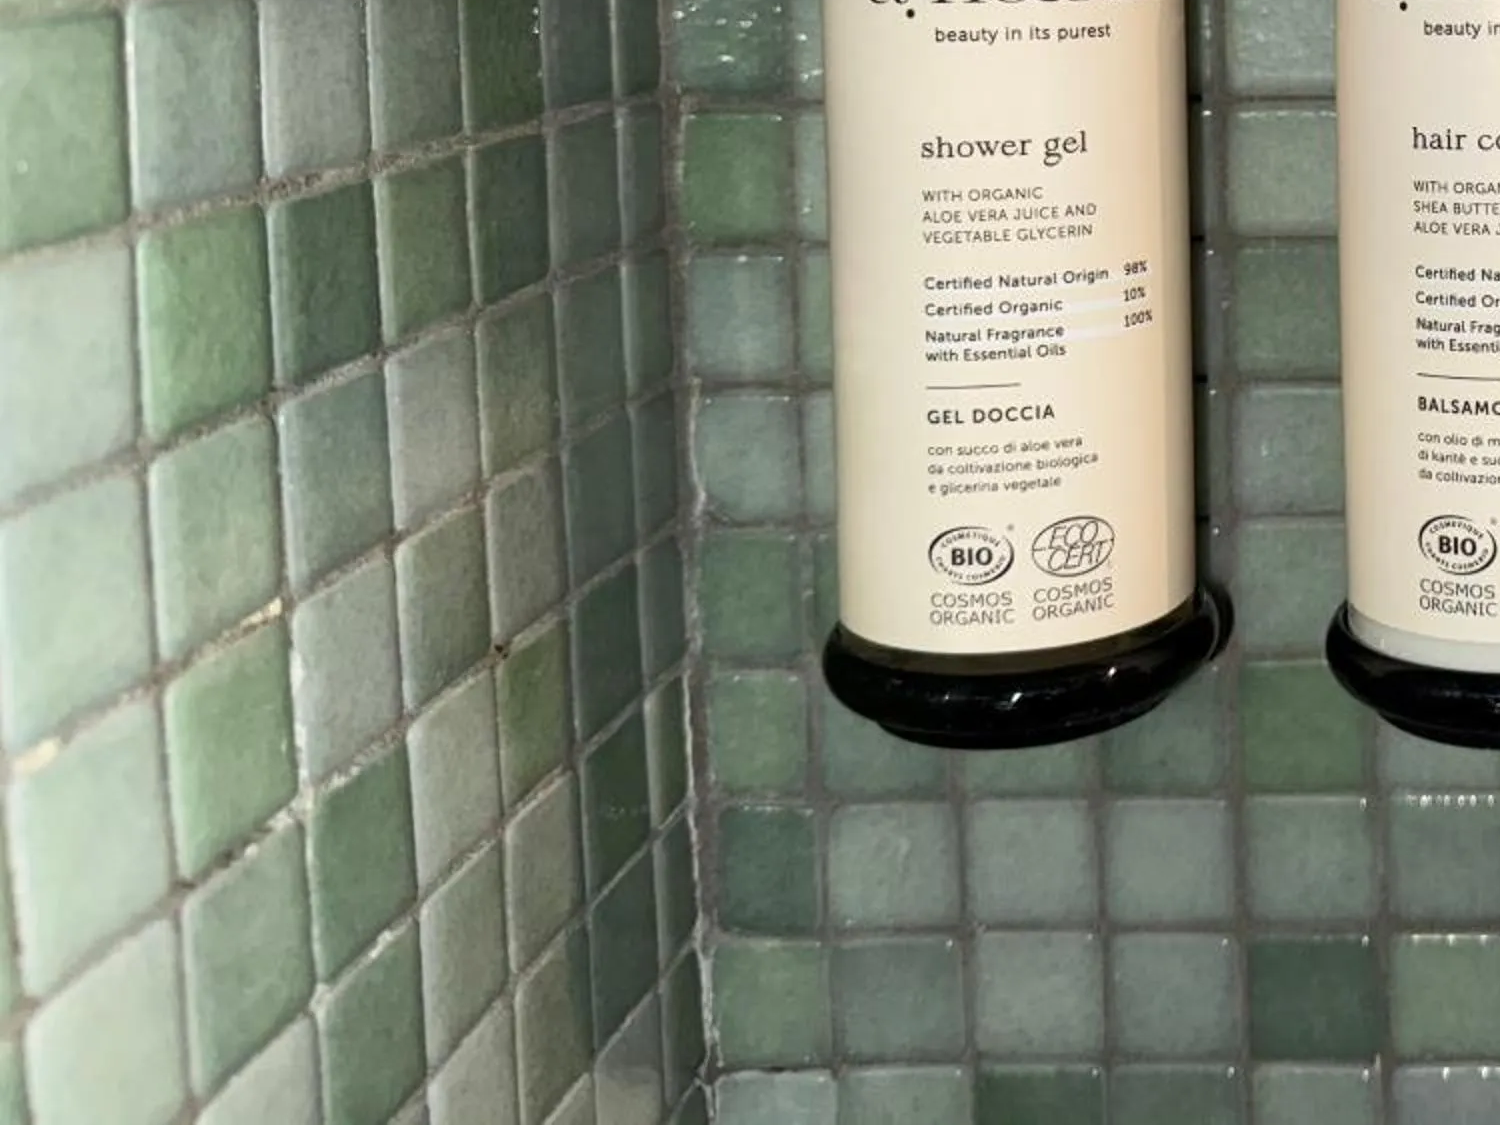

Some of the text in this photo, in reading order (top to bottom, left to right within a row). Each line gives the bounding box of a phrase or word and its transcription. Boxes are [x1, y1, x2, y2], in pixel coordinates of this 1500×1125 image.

[935, 24, 1111, 44] beauty in its purest
[1424, 20, 1481, 39] beauty
[921, 130, 1088, 167] shower gel
[1412, 127, 1466, 151] hair
[922, 187, 1044, 202] WITH ORGANIC
[1414, 180, 1448, 194] WITH
[922, 203, 1096, 223] ALOE VERA JUICE AND
[1413, 201, 1448, 213] SHEA
[923, 224, 1093, 244] VEGETABLE GLYCERIN
[1414, 222, 1448, 234] ALOE
[1453, 223, 1490, 235] VERA
[924, 260, 1147, 290] Certified Natural Origin 98%
[1415, 265, 1476, 282] Certified
[925, 286, 1145, 316] Certified Organic 10%
[1415, 291, 1476, 307] Certified
[925, 310, 1152, 343] Natural Fragrance 100%
[1416, 317, 1465, 333] Natural
[925, 344, 1066, 362] with Essential Oils
[1416, 338, 1444, 350] with
[927, 404, 1055, 424] GEL DOCCIA
[928, 436, 1082, 456] con succo di aloe vera
[1418, 432, 1440, 443] con
[1444, 434, 1467, 446] olio
[928, 452, 1098, 475] da coltivazione biologica
[1470, 456, 1478, 464] e
[1418, 468, 1432, 480] da
[940, 480, 998, 496] glicerina
[1004, 476, 1061, 492] vegetale
[1050, 521, 1099, 550] ECO
[1439, 535, 1476, 556] BIO
[951, 547, 992, 566] BIO
[1048, 540, 1108, 571] CERT
[931, 590, 1013, 608] COSMOS
[1033, 577, 1113, 604] COSMOS
[1420, 579, 1496, 599] COSMOS
[929, 607, 1015, 626] ORGANIC
[1032, 594, 1115, 621] ORGANIC
[1419, 596, 1497, 617] ORGANIC
